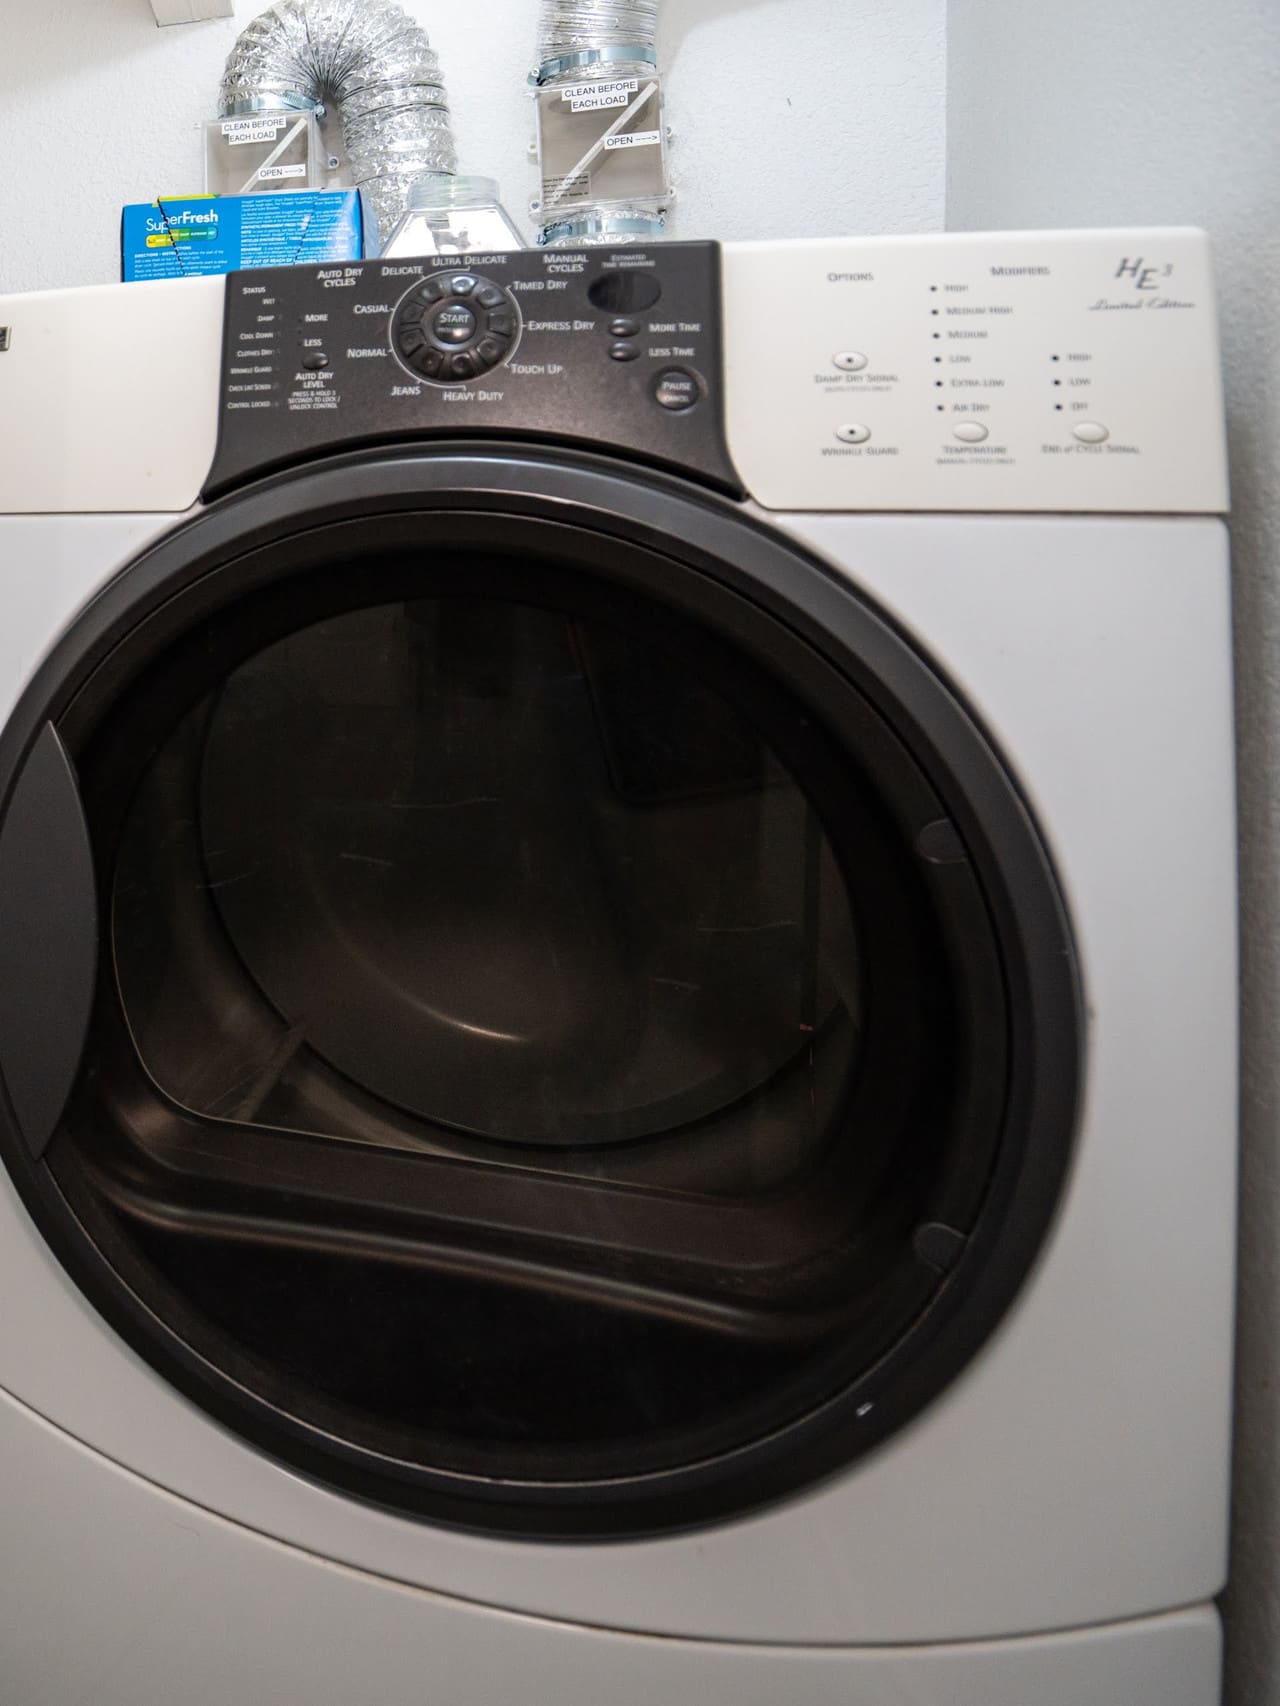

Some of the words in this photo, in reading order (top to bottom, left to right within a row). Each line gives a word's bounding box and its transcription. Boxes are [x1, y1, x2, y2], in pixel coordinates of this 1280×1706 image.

[565, 88, 595, 98] CLEAN
[598, 81, 636, 93] BEFORE
[573, 100, 598, 109] EACH
[600, 95, 626, 105] LOAD
[224, 122, 250, 131] CLEAN
[252, 118, 284, 128] BEFORE
[230, 134, 251, 142] EACH
[253, 131, 274, 139] LOAD
[607, 136, 633, 146] OPEN
[260, 169, 282, 177] OPEN
[432, 257, 462, 266] ULTRA
[465, 256, 507, 265] DELICATE
[543, 254, 589, 263] MANUAL
[317, 269, 342, 280] AUTO
[344, 267, 363, 278] DRY
[382, 266, 423, 276] DELICATE
[547, 264, 584, 273] CYCLES
[827, 272, 874, 282] OPTIONS
[324, 277, 356, 288] CYCLES
[513, 281, 545, 290] TIMED
[547, 280, 568, 290] DRY
[354, 304, 389, 314] CASUAL
[305, 314, 328, 322] MORE
[440, 313, 469, 323] START
[528, 321, 571, 330] EXPRESS
[573, 321, 596, 330] DRY
[649, 323, 676, 332] MORE
[679, 323, 701, 332] TIME
[304, 339, 322, 347] LESS
[347, 348, 387, 358] NORMAL
[648, 348, 671, 356] LESS
[672, 347, 695, 356] TIME
[510, 364, 544, 374] TOUCH
[547, 364, 563, 374] UP
[295, 372, 316, 381] AUTO
[318, 372, 334, 380] DRY
[391, 386, 421, 396] JEANS
[662, 382, 691, 390] PAUSE
[443, 391, 475, 401] HEAVY
[478, 391, 504, 400] DUTY
